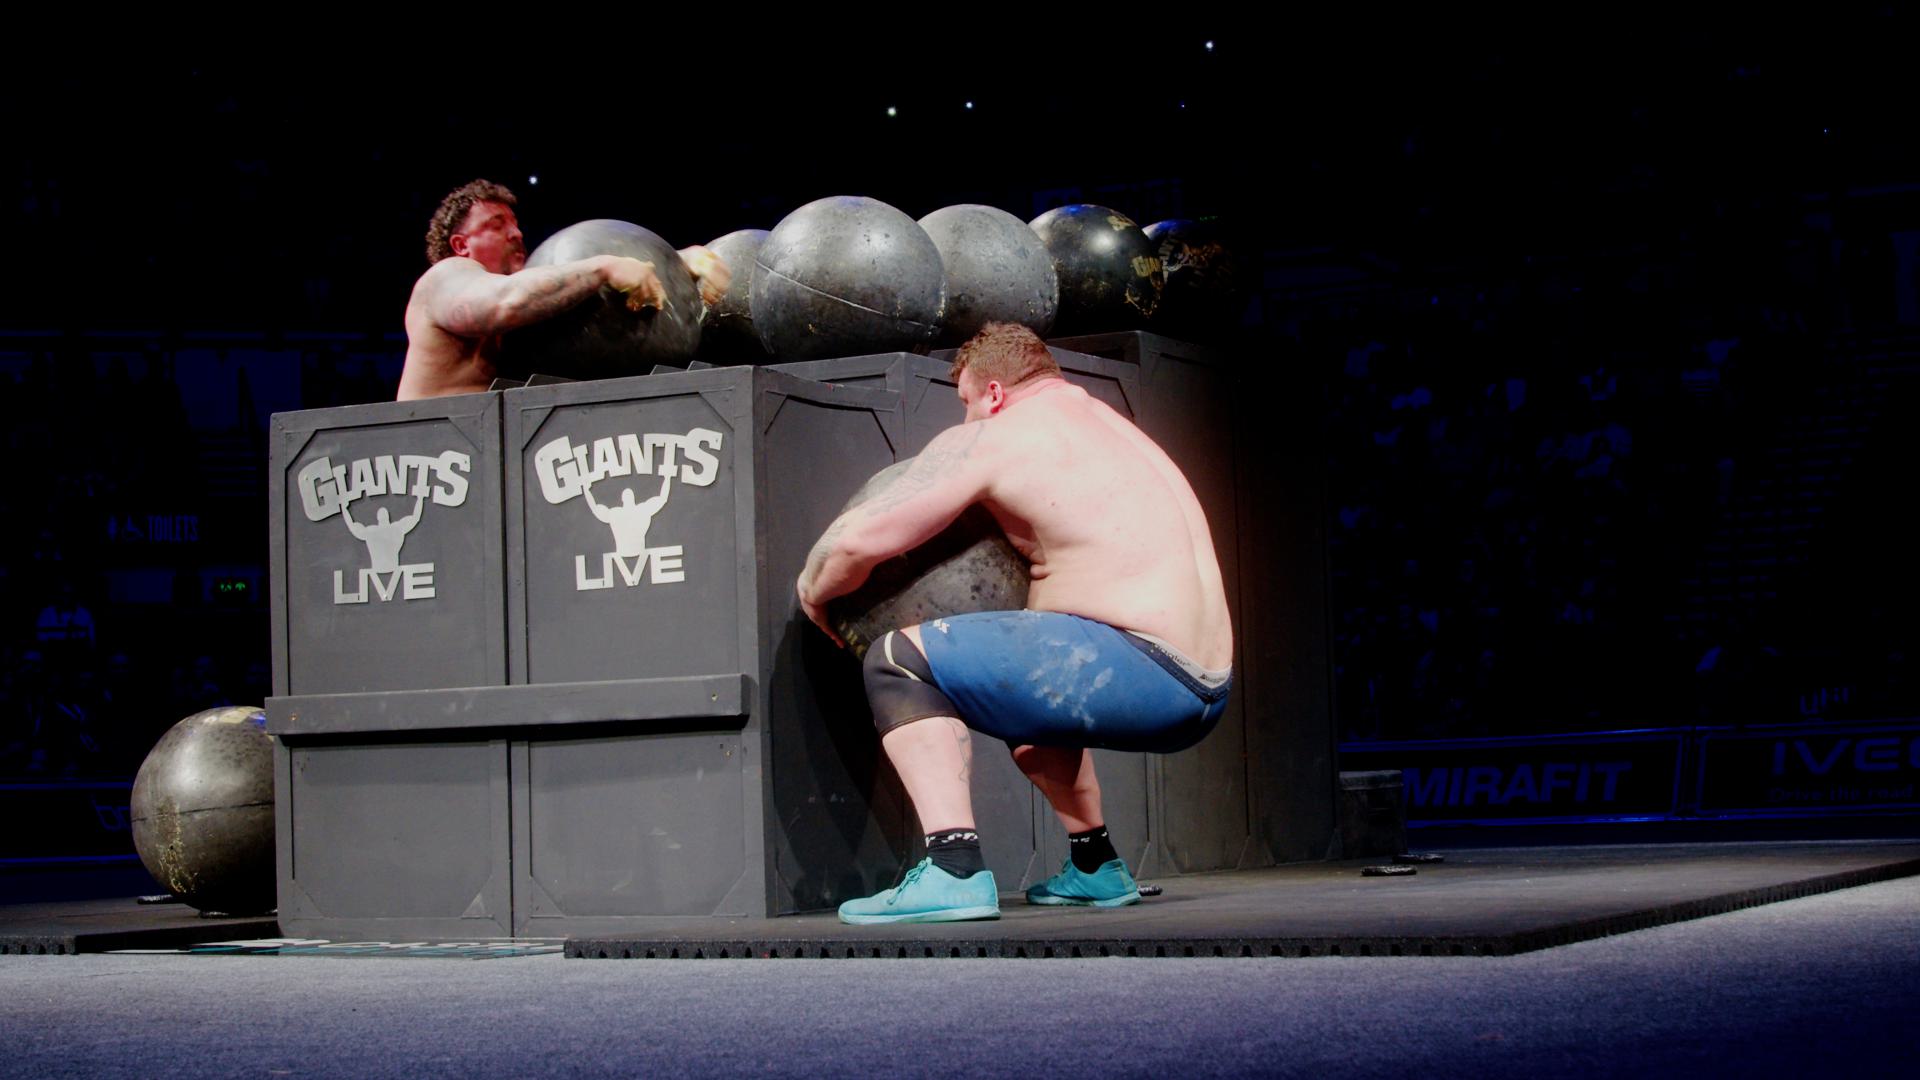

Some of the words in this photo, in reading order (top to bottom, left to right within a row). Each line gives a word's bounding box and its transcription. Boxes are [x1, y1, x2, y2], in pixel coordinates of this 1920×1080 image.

[298, 450, 471, 522] GIANTS
[534, 427, 724, 505] GIANTS
[147, 513, 201, 543] TOILETS
[333, 562, 436, 604] LIVE
[575, 545, 685, 591] LIVE
[1771, 737, 1920, 775] IVE
[1402, 763, 1632, 807] MIRAFIT
